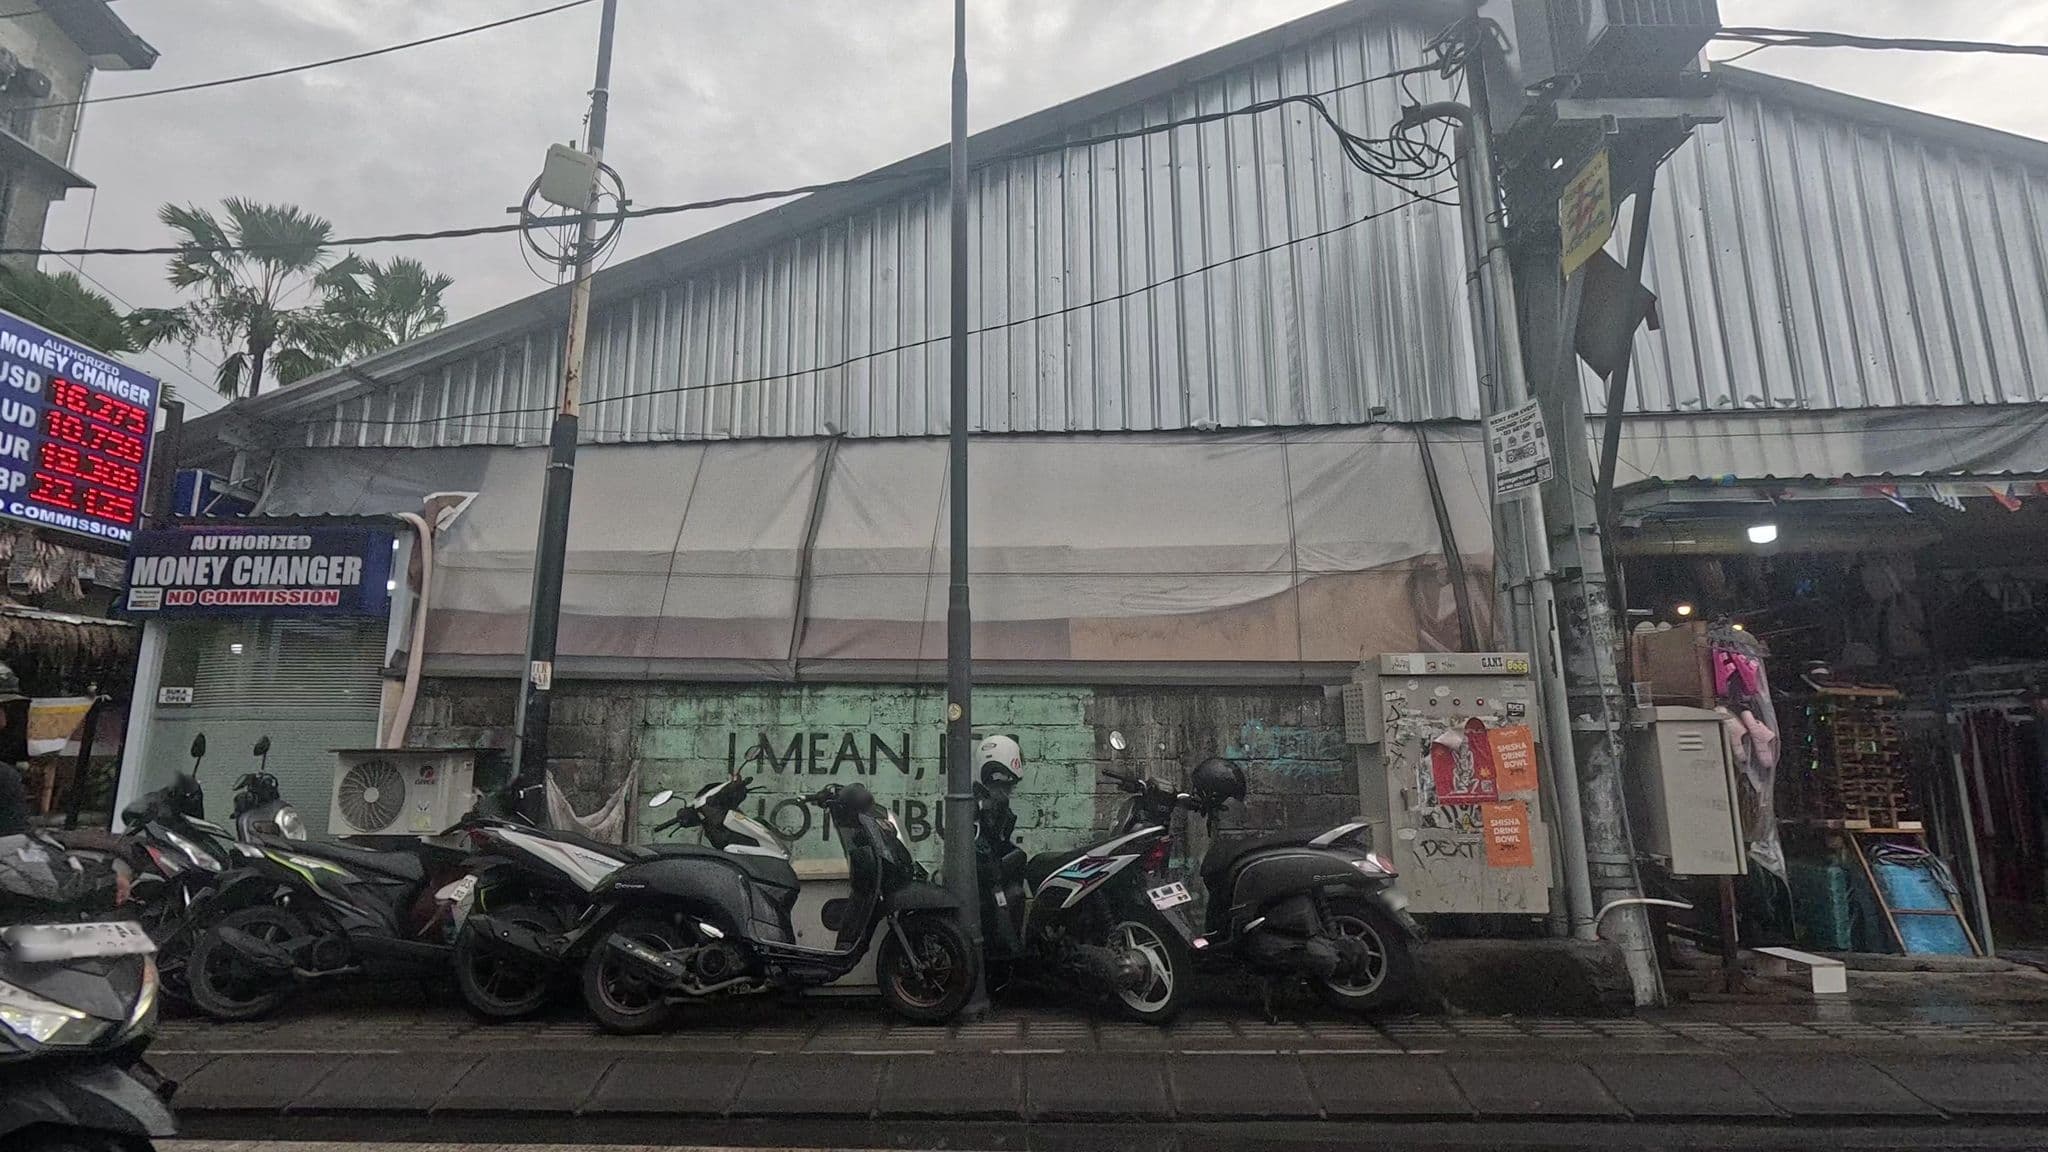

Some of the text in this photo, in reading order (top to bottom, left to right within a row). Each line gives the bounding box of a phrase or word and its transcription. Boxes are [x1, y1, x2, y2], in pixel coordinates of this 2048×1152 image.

[1, 331, 150, 406] MONEY CHANGER
[44, 338, 120, 377] AUTHORIZED
[1, 398, 37, 429] UD
[52, 378, 148, 434] 16.275
[0, 432, 31, 462] UR
[10, 502, 132, 541] COMMISSION
[190, 535, 312, 550] AUTHORIZED
[131, 555, 363, 586] MONEY CHANGER
[165, 589, 198, 605] NO
[199, 589, 340, 605] COMMISSION
[728, 732, 736, 775] I
[756, 732, 925, 780] MEAN,
[1497, 742, 1528, 752] SHISHA
[1501, 750, 1528, 761] DRINK
[1503, 759, 1528, 769] BOWL
[1490, 818, 1521, 827] SHISHA
[1493, 827, 1520, 836] DRINK
[1495, 835, 1521, 844] BOWL
